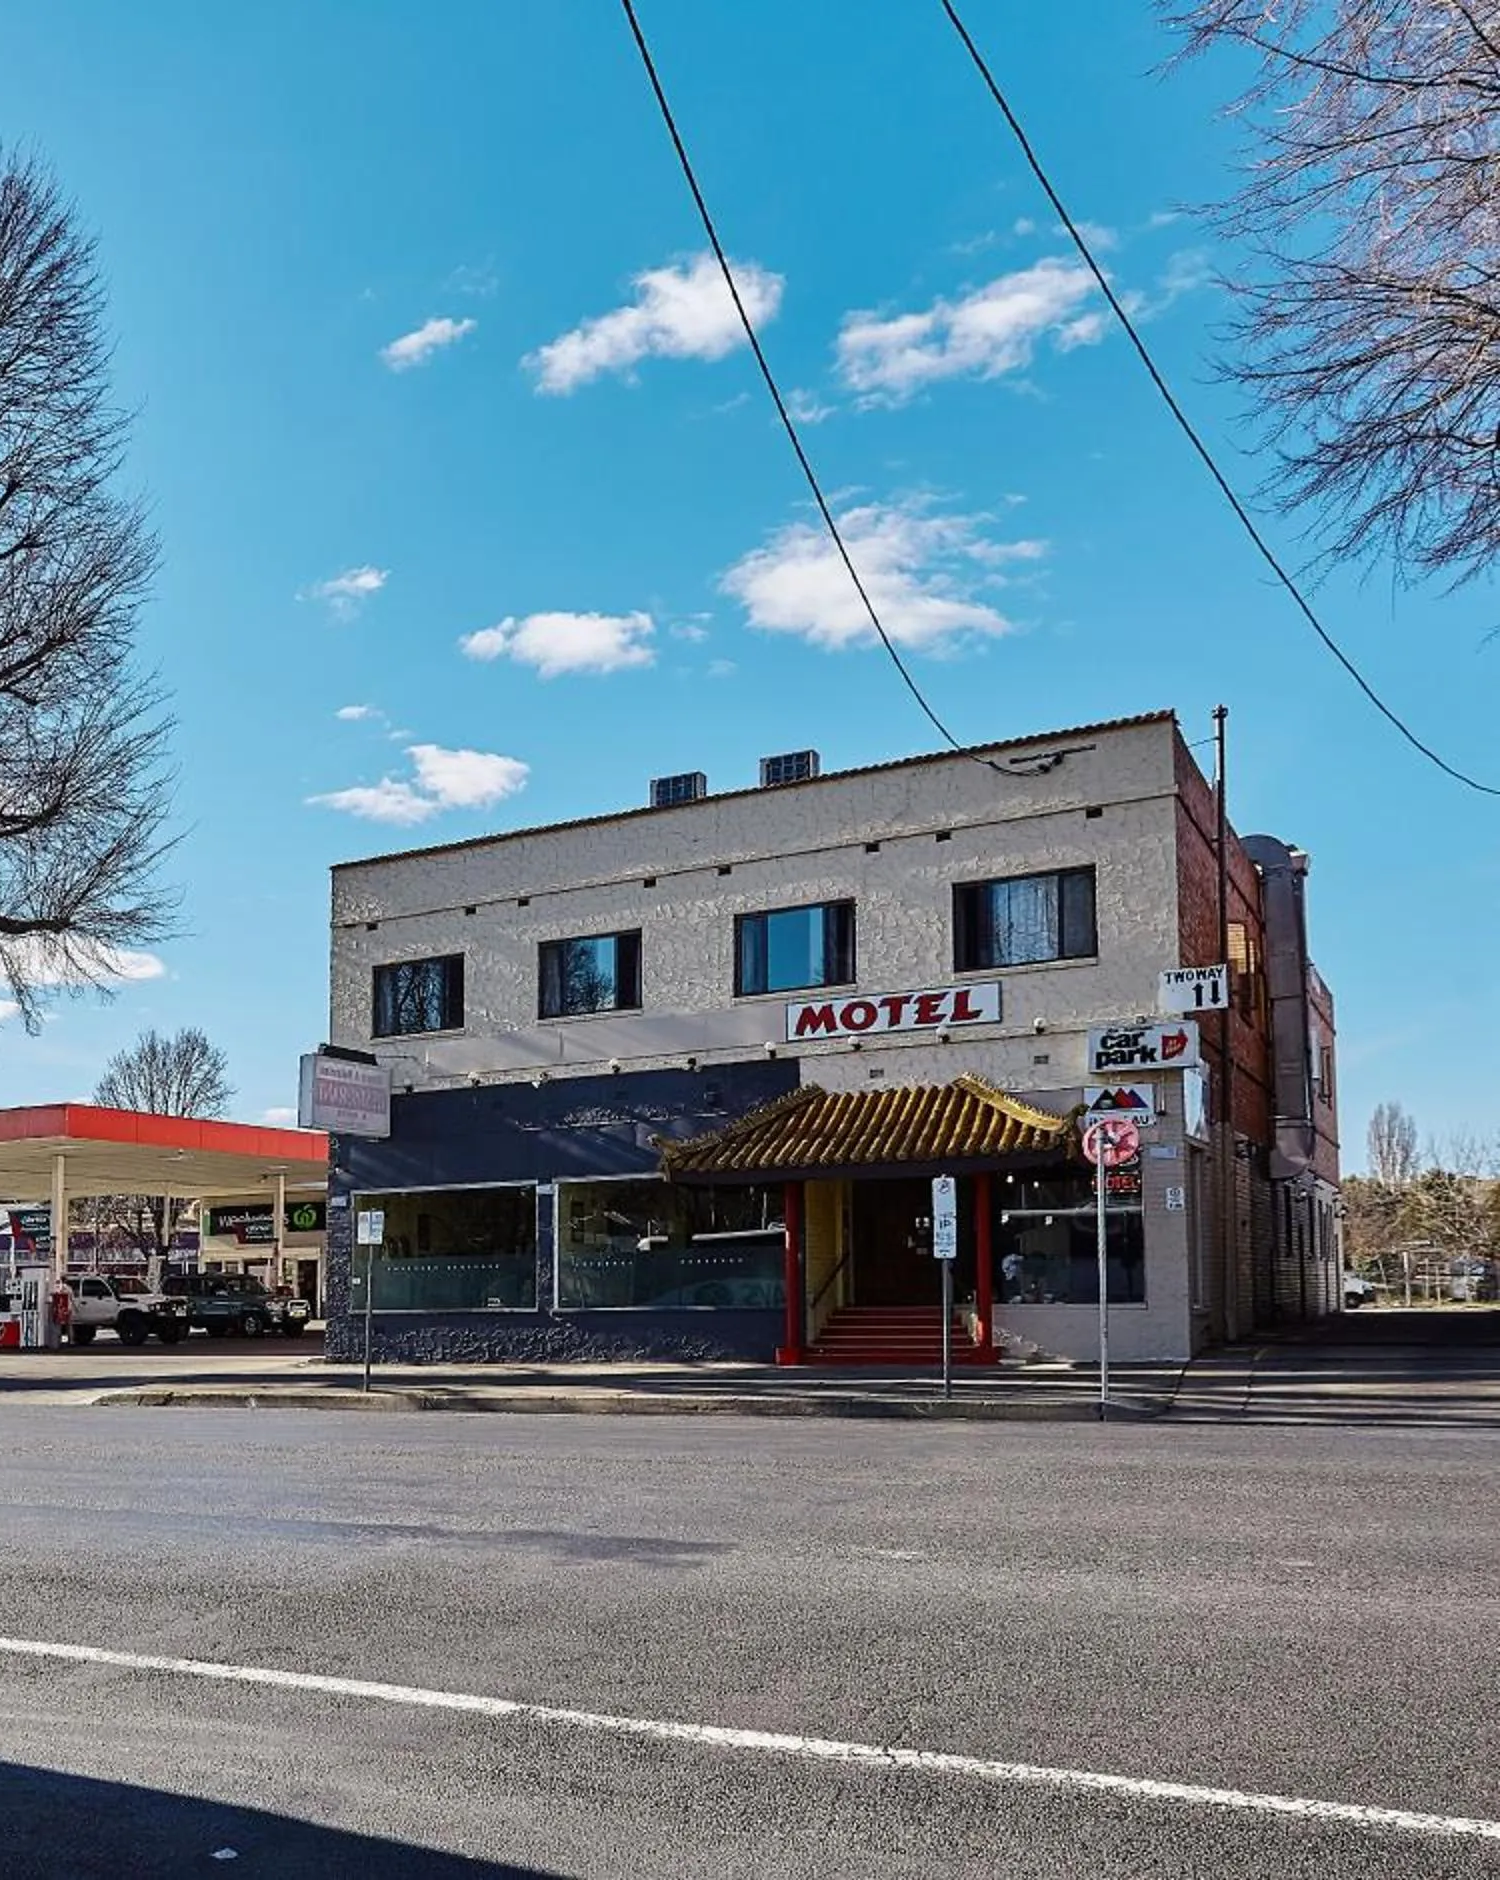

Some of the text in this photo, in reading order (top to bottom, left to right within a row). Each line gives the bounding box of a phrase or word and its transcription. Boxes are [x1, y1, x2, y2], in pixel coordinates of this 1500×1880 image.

[795, 989, 983, 1036] MOTEL
[1100, 1032, 1145, 1050] car
[1096, 1045, 1157, 1069] park
